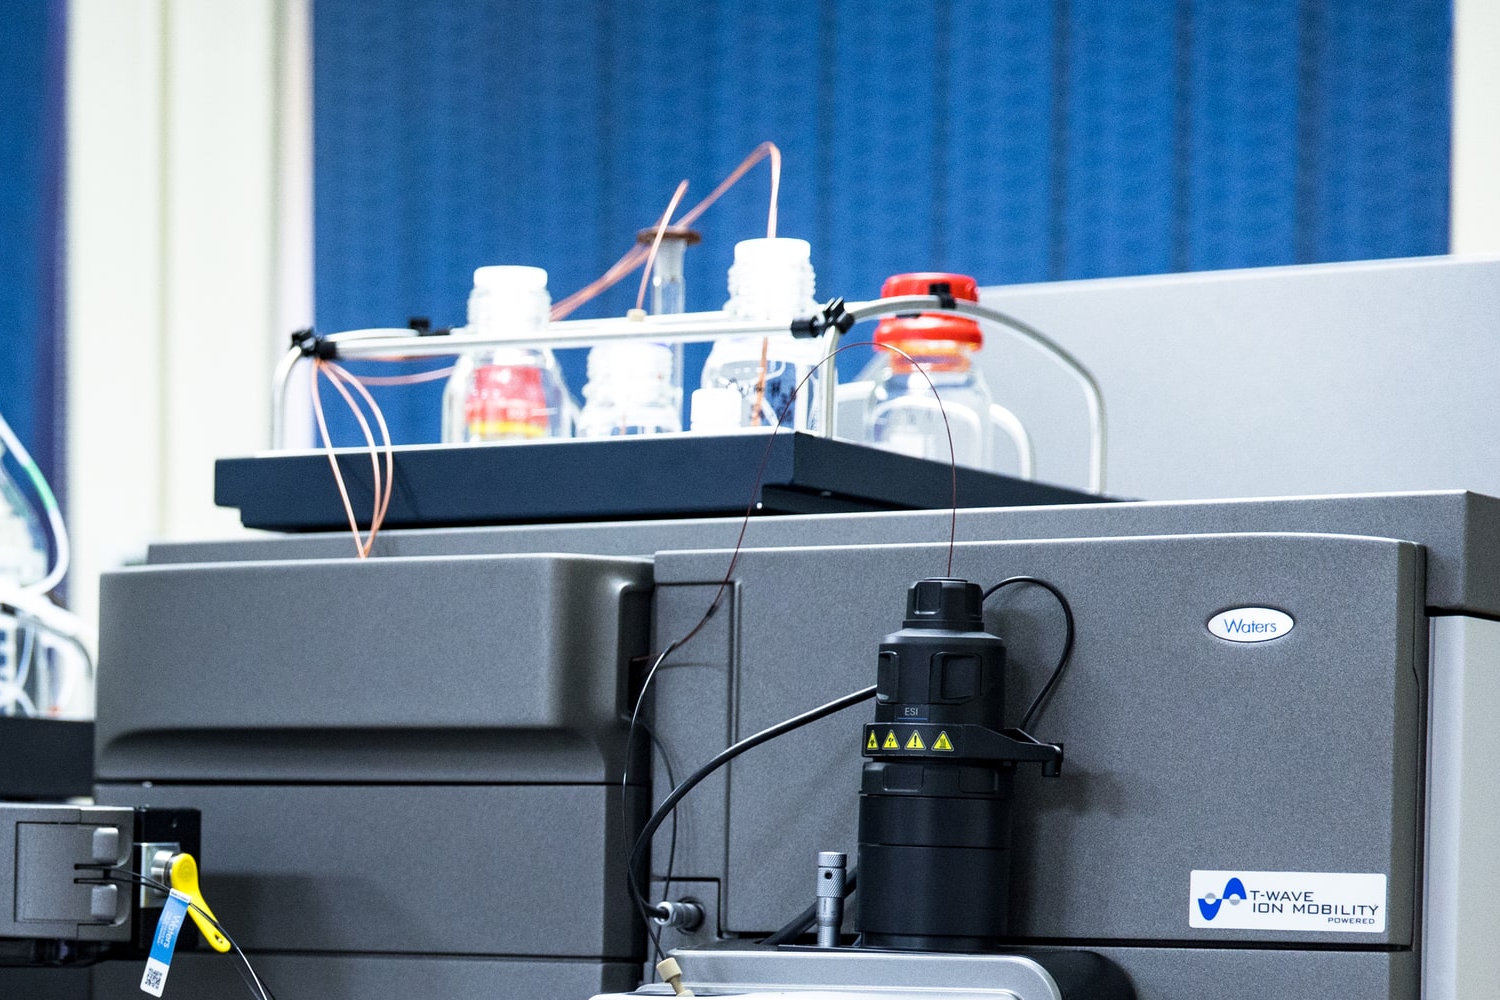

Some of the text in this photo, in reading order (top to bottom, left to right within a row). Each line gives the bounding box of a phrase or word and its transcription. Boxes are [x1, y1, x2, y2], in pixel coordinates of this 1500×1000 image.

[1224, 618, 1277, 634] Waters
[904, 707, 919, 716] ESI
[1250, 890, 1314, 902] T-WAVE
[1252, 902, 1283, 914] ION
[1292, 904, 1379, 916] MOBILITY
[1327, 917, 1376, 925] POWERED
[163, 914, 182, 949] Waters
